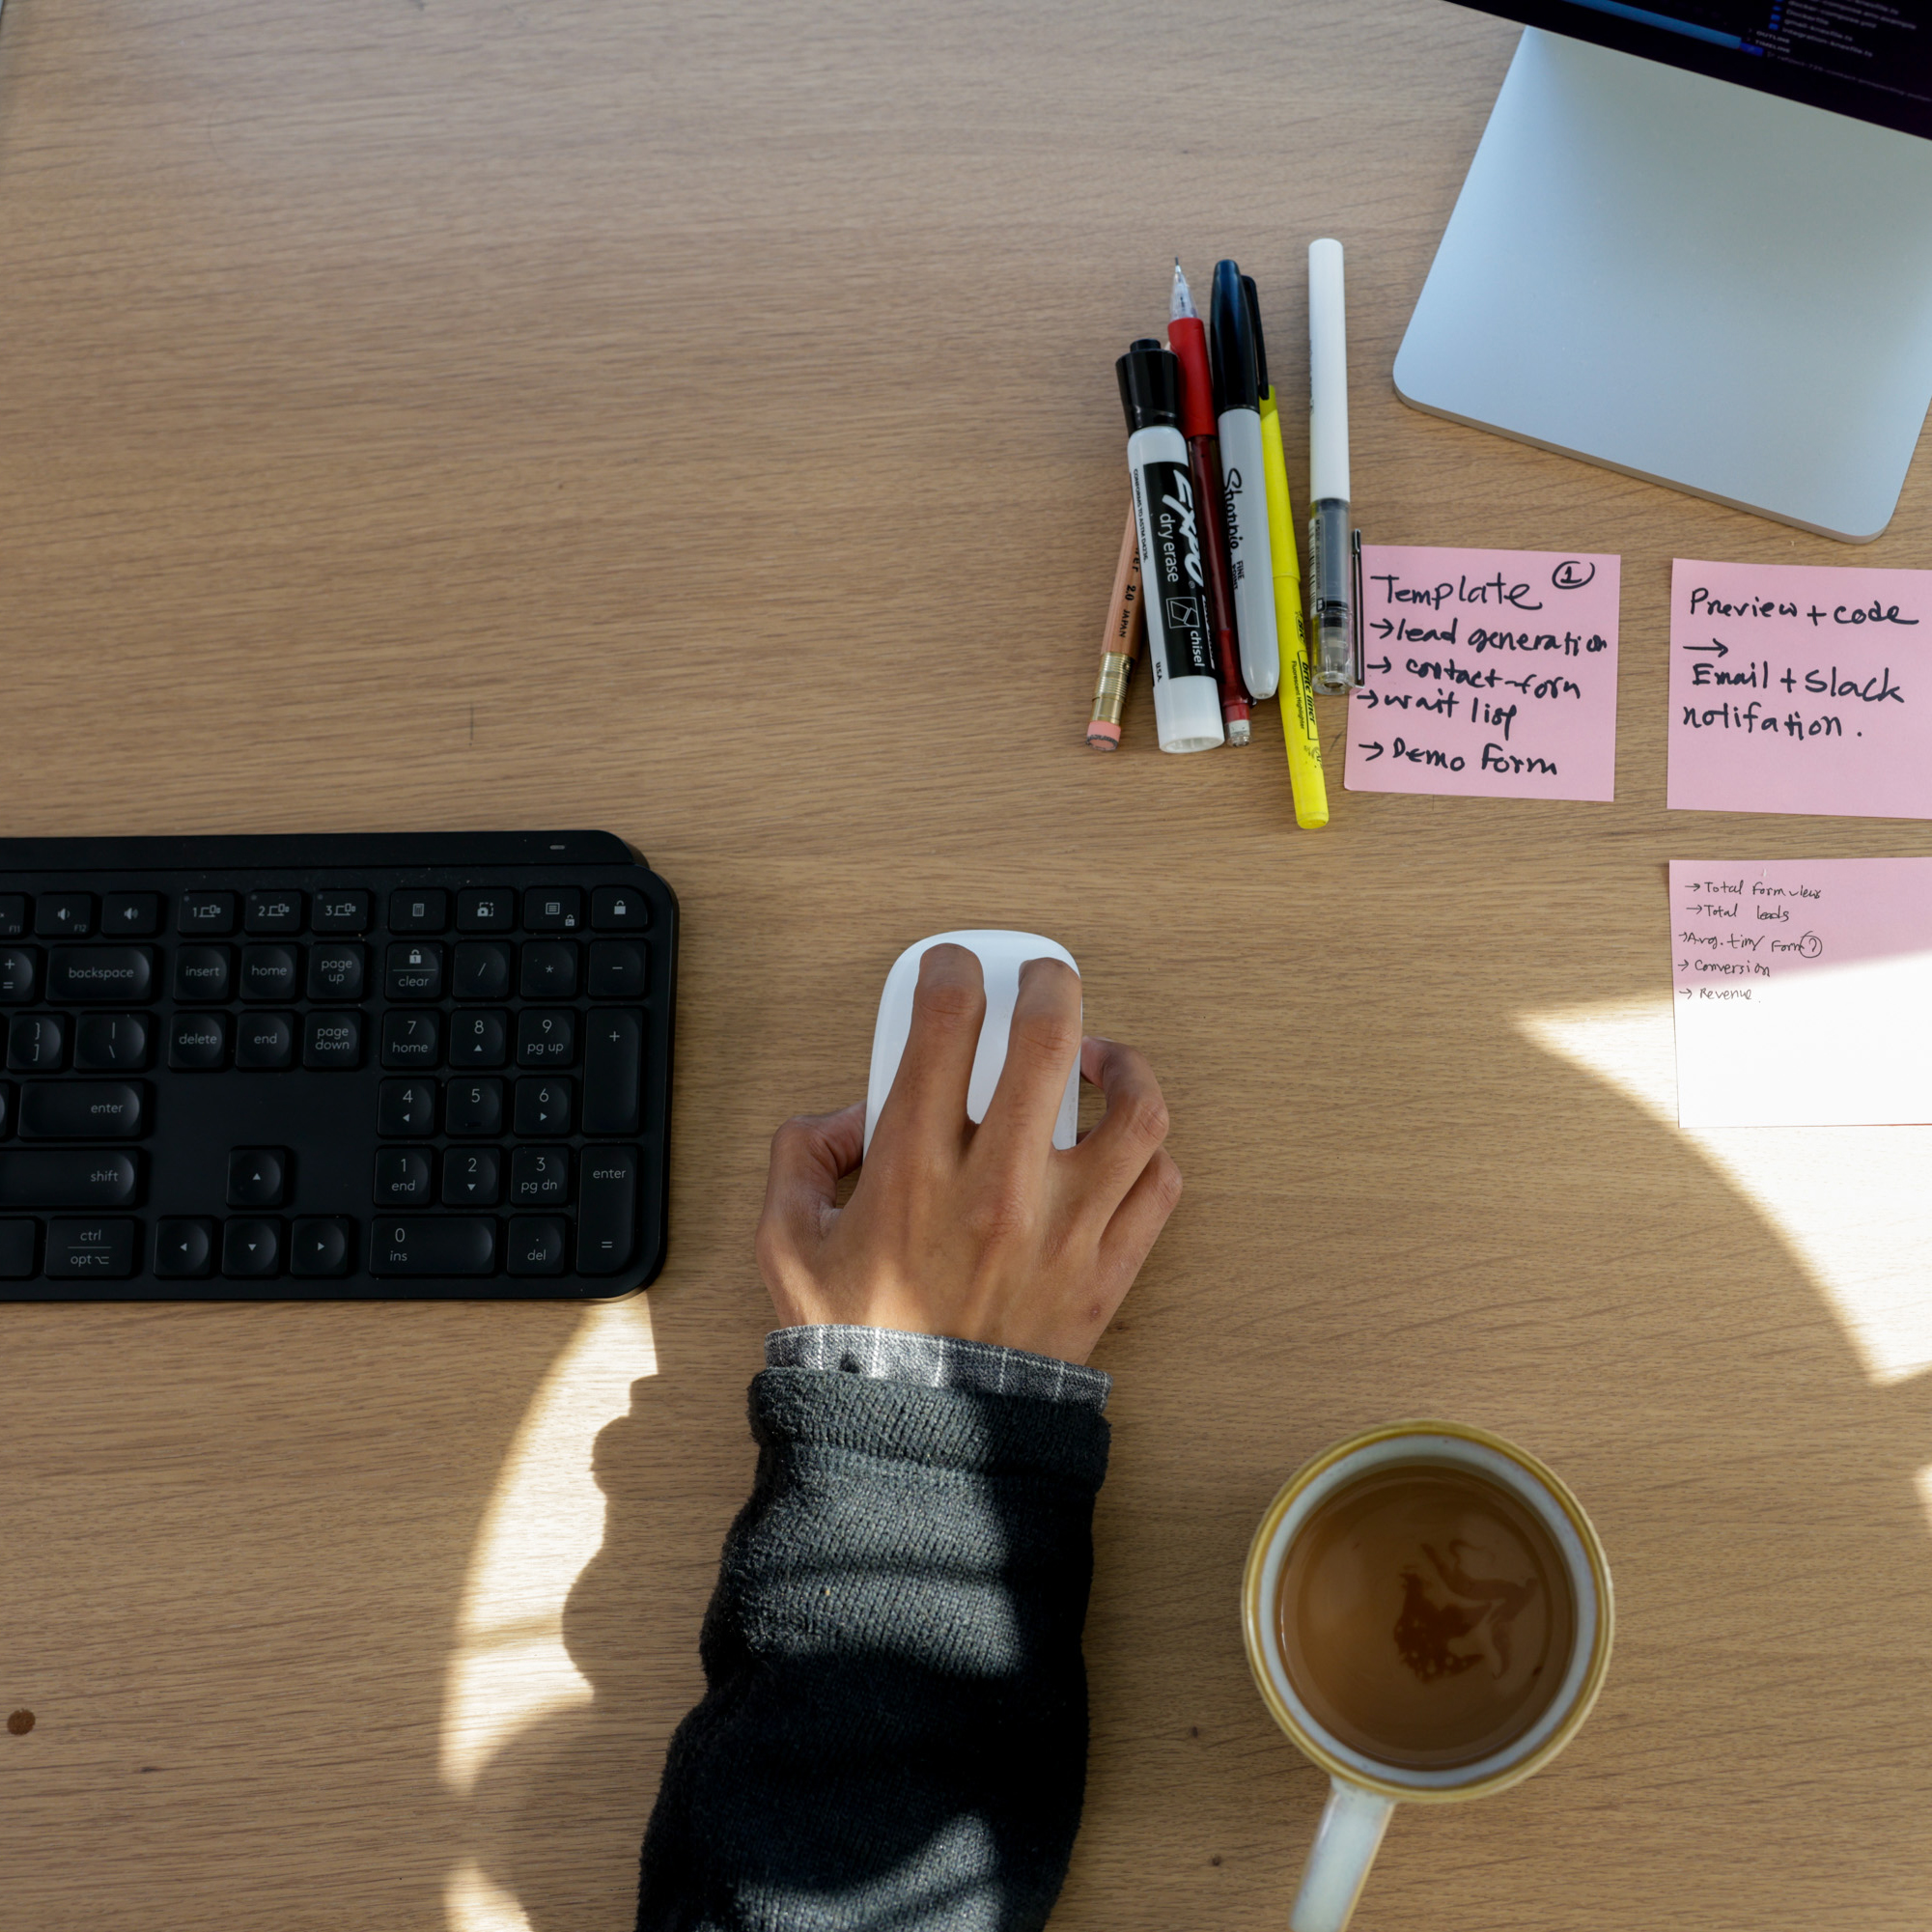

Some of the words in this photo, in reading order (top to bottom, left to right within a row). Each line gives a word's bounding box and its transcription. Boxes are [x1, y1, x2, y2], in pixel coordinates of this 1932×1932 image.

[1756, 30, 1791, 44] OUTLINE
[1755, 39, 1792, 53] TIMELINE
[1134, 468, 1143, 508] CONFORMS
[1136, 507, 1144, 518] TO
[1138, 518, 1147, 538] ASTM
[1159, 513, 1176, 539] dry
[1163, 542, 1179, 583] erase
[1236, 560, 1246, 581] FINE
[1124, 584, 1136, 602] 2.0
[1370, 572, 1543, 610] Template
[1691, 587, 1798, 618] Preview
[1833, 600, 1919, 626] code
[1118, 609, 1131, 638] JAPAN
[1396, 618, 1458, 645] lead
[1468, 628, 1608, 656] generation
[1190, 630, 1205, 667] chisel
[1291, 660, 1302, 697] Fluorescent
[1302, 660, 1313, 693] brite
[1692, 660, 1768, 688] Email
[1805, 666, 1905, 704] Slack
[1305, 694, 1316, 725] liner
[1385, 688, 1459, 717] wait
[1295, 696, 1306, 730] Highlighter
[1392, 738, 1466, 771] Demo
[1481, 742, 1557, 775] Form
[1704, 880, 1744, 895] Total
[1704, 903, 1738, 917] Total
[9, 924, 21, 934] F11
[73, 924, 87, 934] F12
[69, 966, 134, 980] backspace
[185, 965, 220, 978] insert
[251, 965, 288, 977] home
[322, 960, 353, 972] page
[1694, 959, 1771, 978] Conversion
[328, 973, 345, 985] up
[398, 975, 430, 987] clear
[317, 1027, 350, 1040] page
[406, 1021, 417, 1035] 7
[474, 1020, 485, 1035] 8
[542, 1020, 552, 1033] 9
[179, 1032, 218, 1045] delete
[254, 1032, 278, 1045] end
[609, 1030, 621, 1043] +
[315, 1039, 350, 1050] down
[392, 1041, 429, 1053] home
[527, 1042, 545, 1055] pg
[547, 1042, 565, 1054] up
[403, 1089, 414, 1104] 4
[471, 1088, 481, 1103] 5
[539, 1088, 550, 1103] 6
[91, 1103, 125, 1114] enter
[400, 1159, 407, 1173] 1
[467, 1158, 478, 1172] 2
[536, 1157, 546, 1172] 3
[90, 1170, 120, 1182] shift
[593, 1167, 627, 1180] enter
[391, 1180, 416, 1192] end
[520, 1181, 539, 1194] pg
[542, 1179, 558, 1191] dn
[80, 1229, 102, 1242] ctrl
[394, 1227, 406, 1243] 0
[70, 1254, 92, 1267] opt
[390, 1250, 408, 1263] ins
[527, 1248, 547, 1261] del
